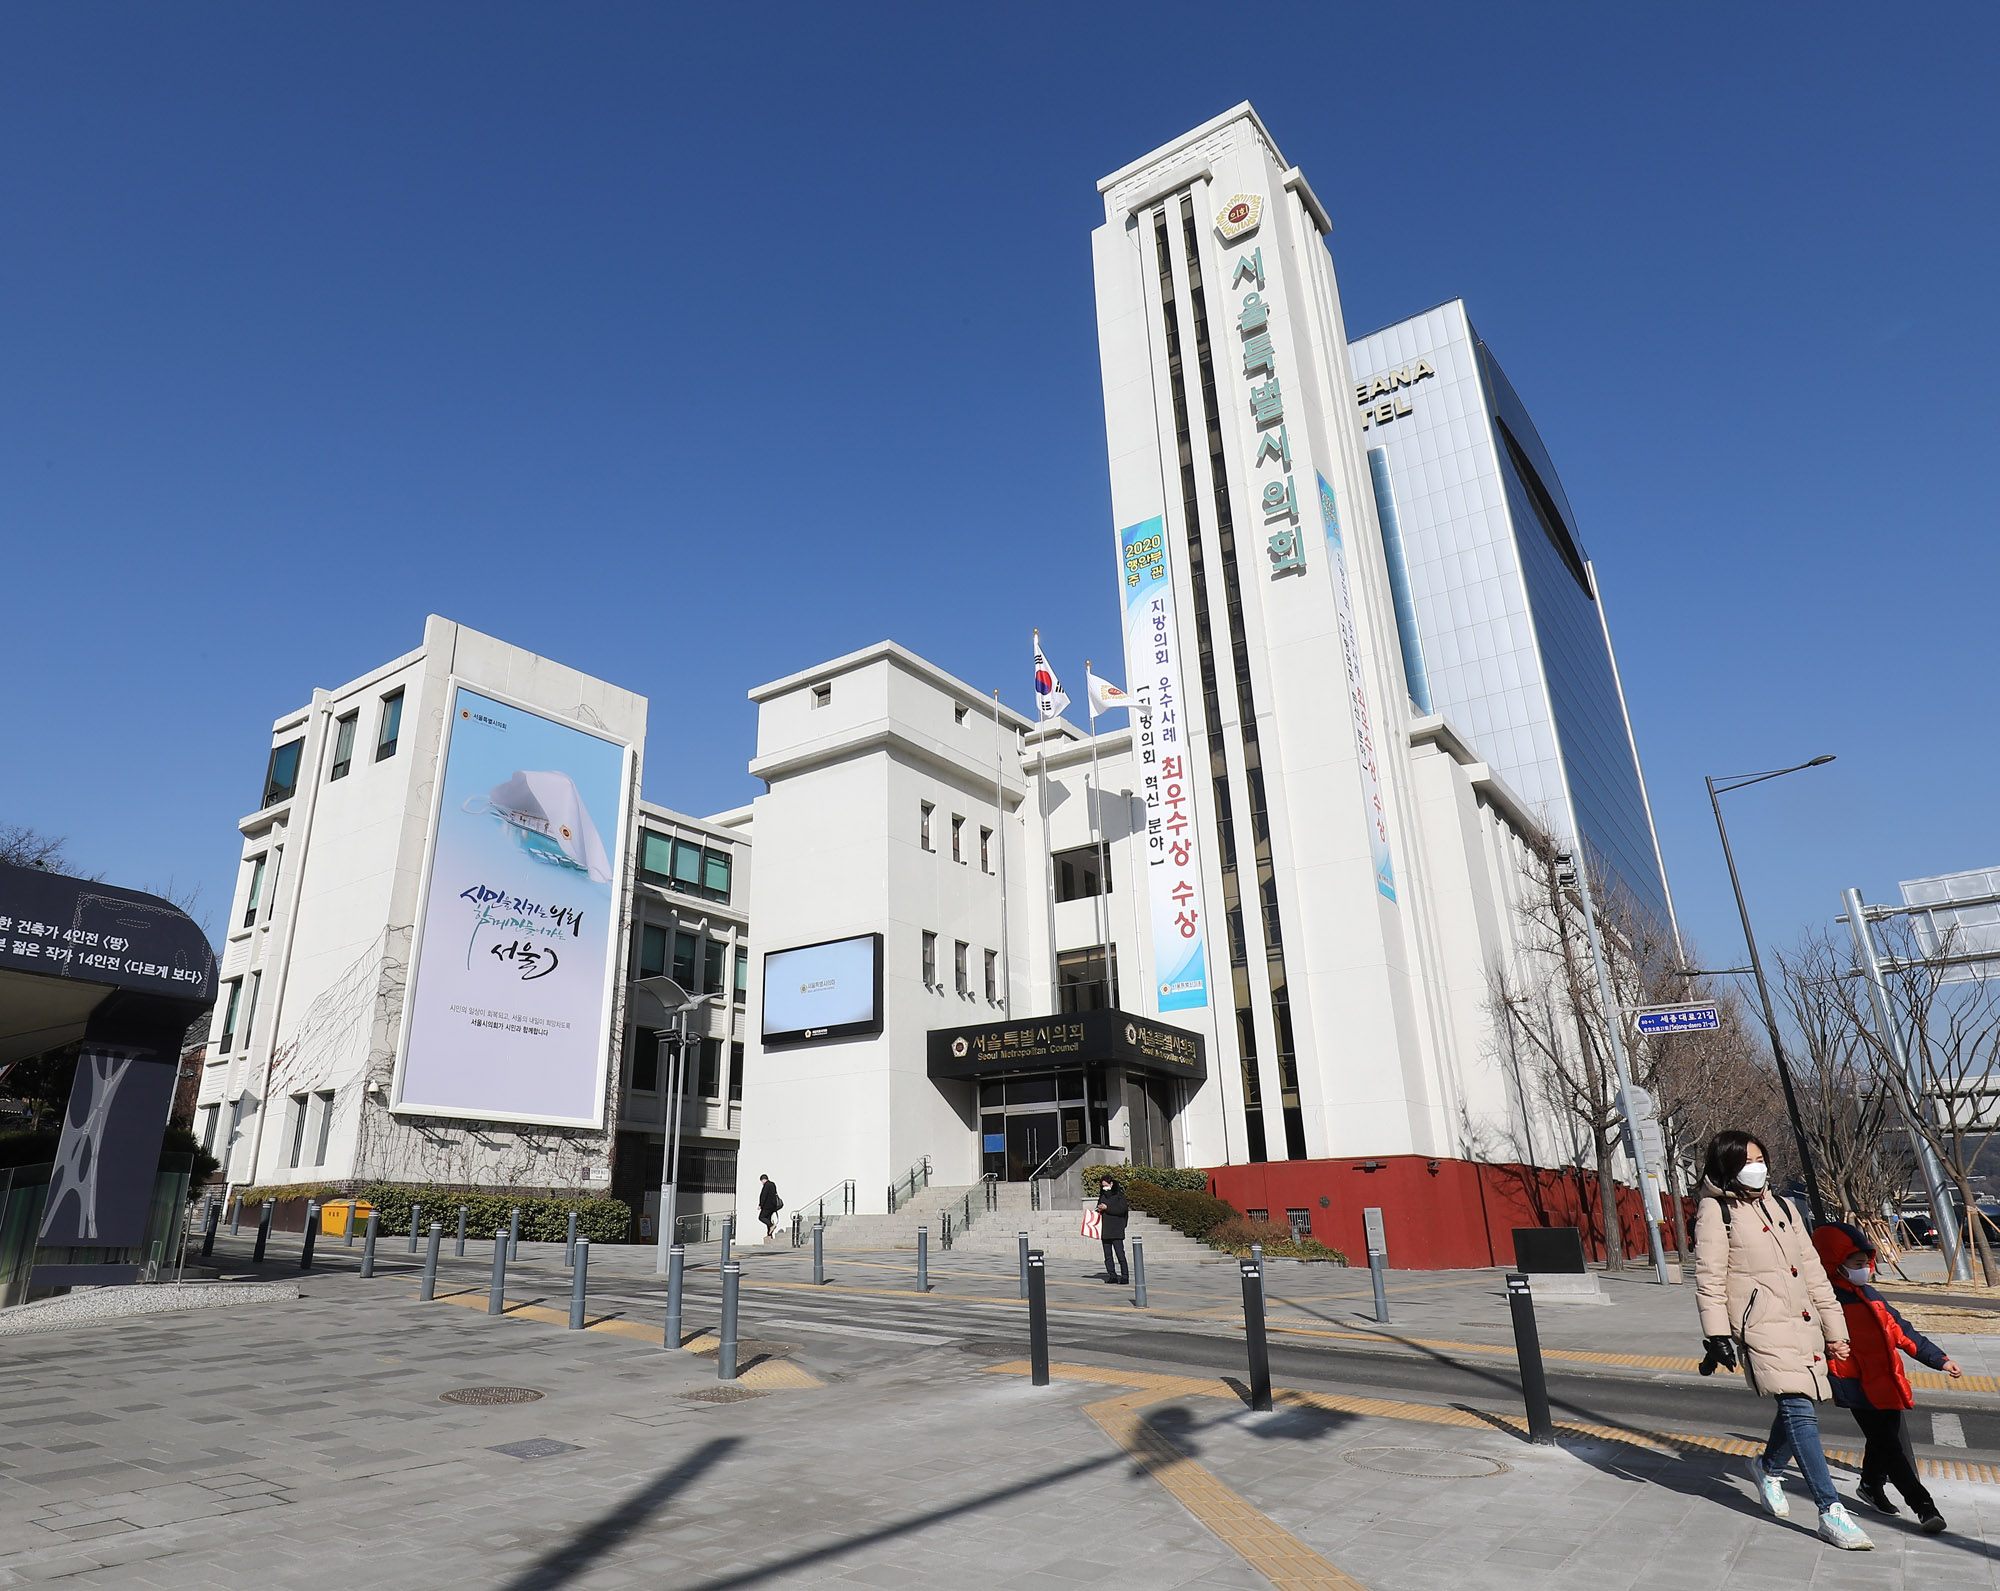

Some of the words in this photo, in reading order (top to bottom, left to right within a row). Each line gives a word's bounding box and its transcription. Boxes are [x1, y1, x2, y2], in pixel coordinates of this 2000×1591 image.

[1230, 204, 1249, 222] 의회
[1233, 246, 1306, 573] 서울특별시의회
[1125, 534, 1161, 559] 2020
[1126, 550, 1163, 572] 행안부
[1151, 598, 1169, 665] 지방의회
[1158, 676, 1177, 743] 우수사례
[1145, 775, 1160, 808] 혁신
[1161, 755, 1192, 867] 최우수상
[460, 884, 512, 910] 시민을
[513, 897, 548, 918] 지키는
[550, 905, 584, 937] 의회
[1171, 880, 1198, 939] 수상
[16, 919, 60, 940] 건축가
[62, 929, 99, 946] 4인전
[12, 940, 40, 958] 젊은
[45, 946, 73, 964] 작가
[78, 952, 120, 972] 14인전
[490, 940, 558, 980] 서울
[450, 1004, 468, 1014] 시민의
[468, 1008, 486, 1017] 일상이
[512, 1014, 528, 1023] 서울의
[529, 1016, 544, 1026] 내일이
[471, 1018, 504, 1030] 서울시의회가
[505, 1023, 522, 1033] 시민과
[523, 1026, 549, 1036] 함께합니다
[1660, 1010, 1714, 1024] 세종대로21길
[972, 1022, 1085, 1052] 서울특별시의회
[978, 1052, 998, 1061] Seoul
[1000, 1046, 1046, 1059] Metropolitan
[1050, 1042, 1079, 1054] Council
[1138, 1028, 1196, 1058] 서울특별시의회
